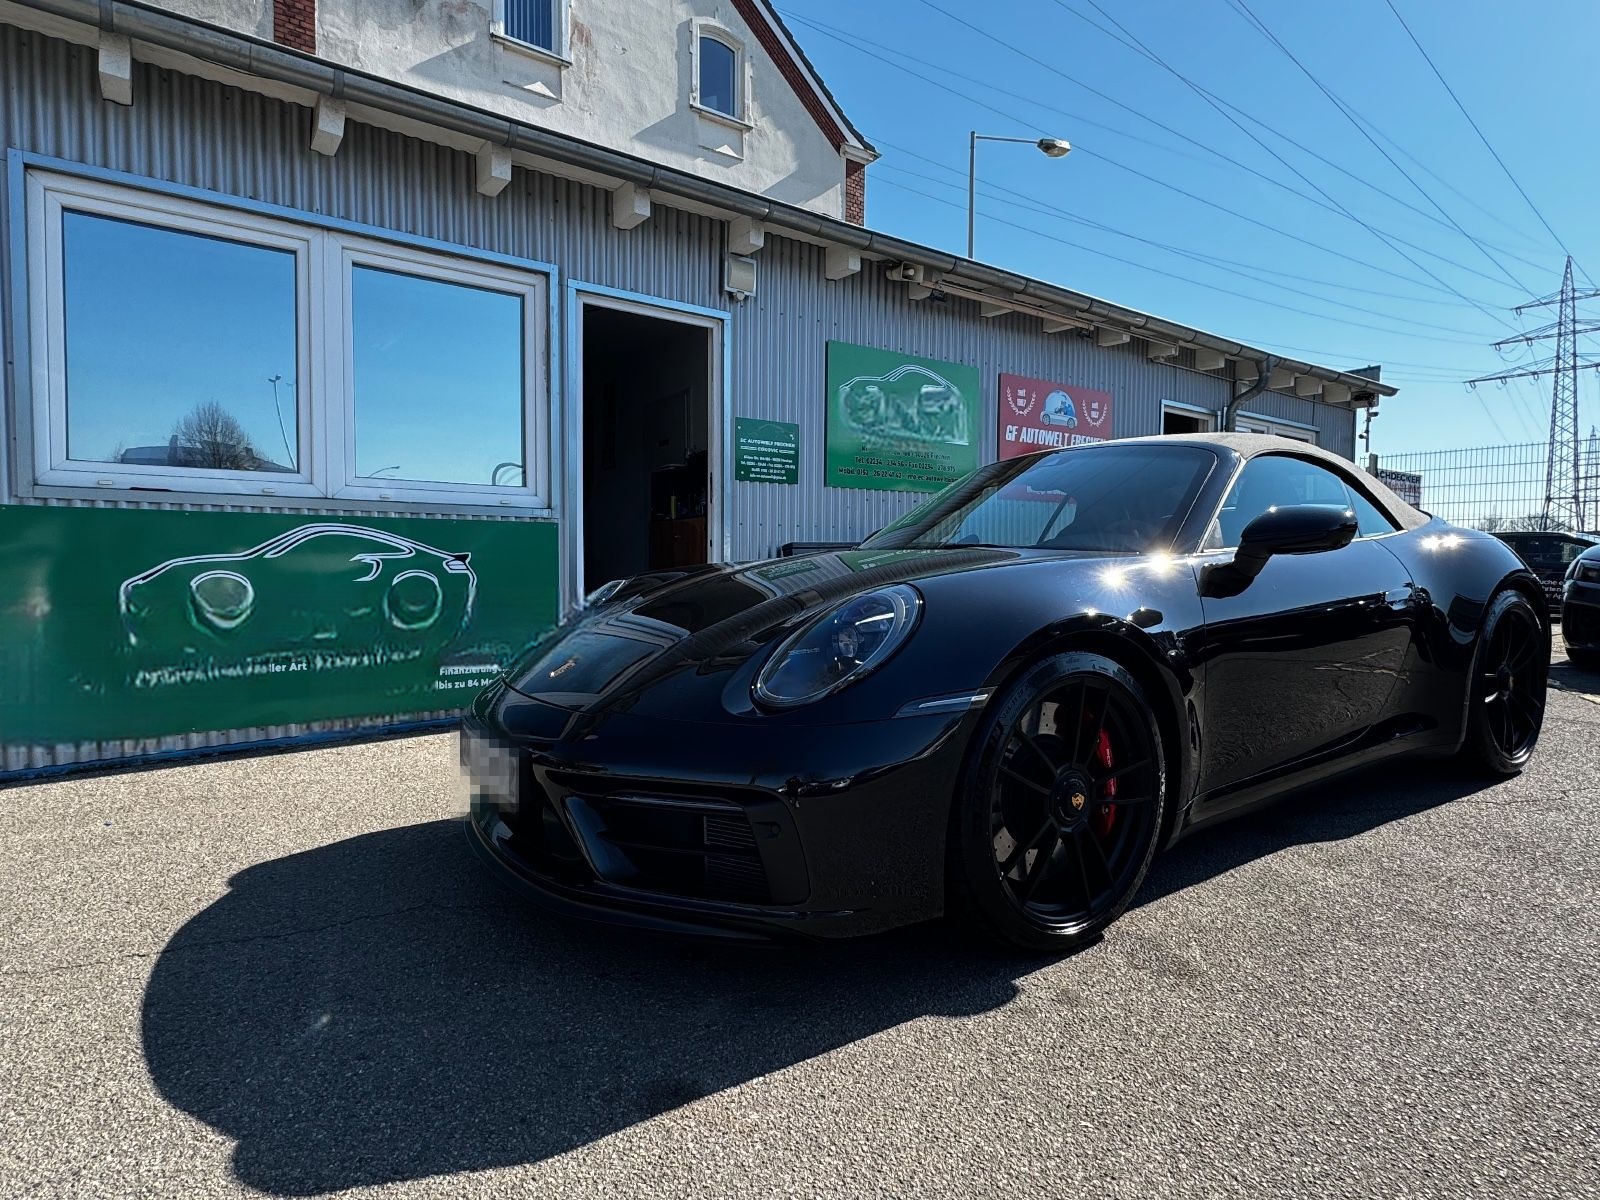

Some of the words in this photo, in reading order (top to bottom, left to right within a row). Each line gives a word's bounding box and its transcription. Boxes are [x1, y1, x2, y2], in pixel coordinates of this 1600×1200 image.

[1005, 424, 1019, 442] GF
[1019, 426, 1070, 447] AUTOWELT
[1070, 433, 1106, 447] FREC
[288, 661, 307, 672] Art
[454, 680, 466, 689] zu
[467, 678, 480, 688] 84
